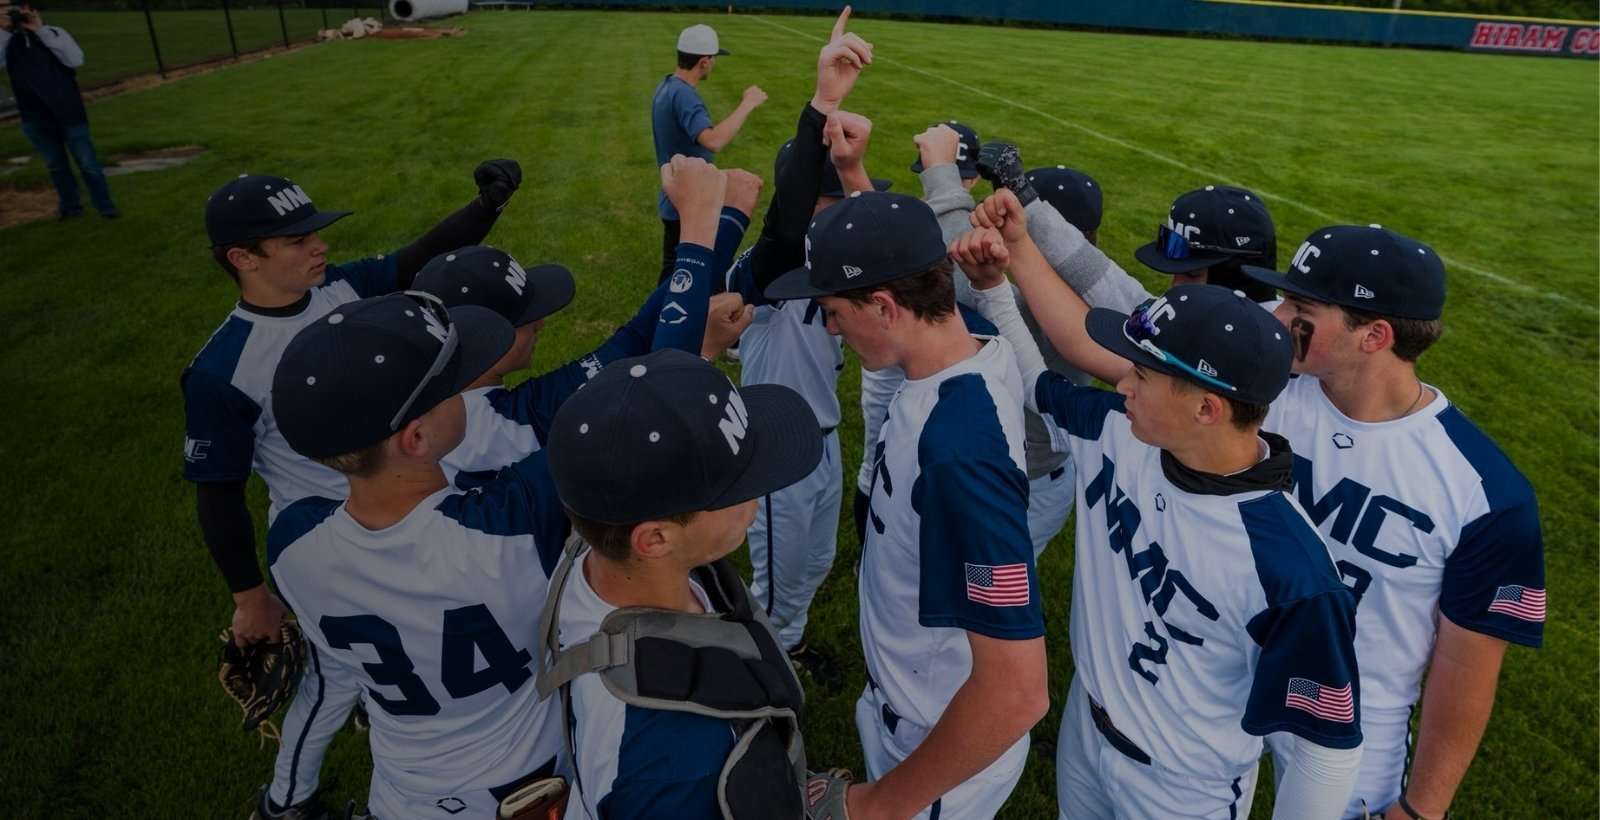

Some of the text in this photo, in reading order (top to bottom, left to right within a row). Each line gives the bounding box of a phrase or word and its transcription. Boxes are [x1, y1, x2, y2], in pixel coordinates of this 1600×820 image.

[1470, 22, 1569, 52] HIRAM
[1085, 453, 1221, 647] NMC
[318, 603, 534, 716] 34
[1128, 621, 1169, 686] 2
